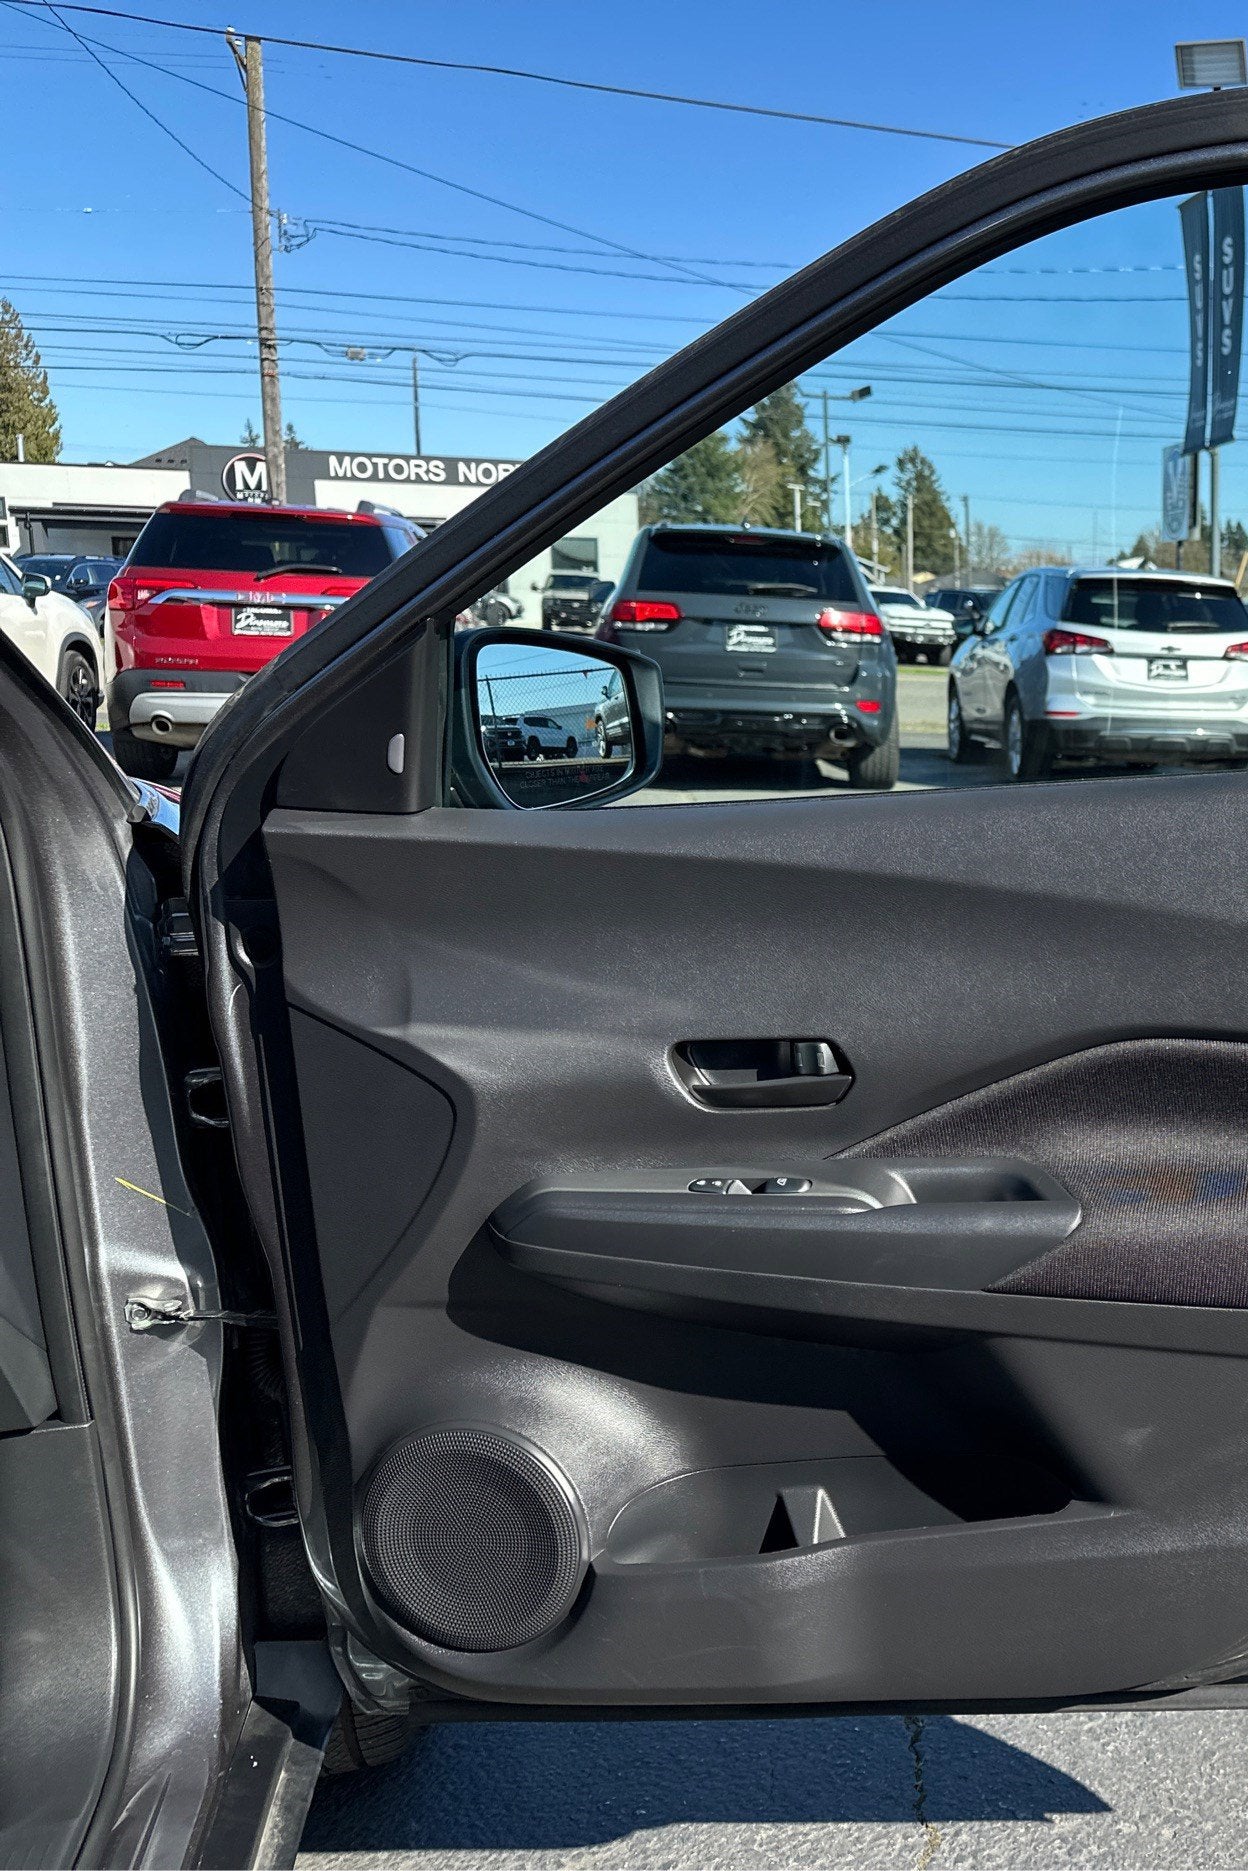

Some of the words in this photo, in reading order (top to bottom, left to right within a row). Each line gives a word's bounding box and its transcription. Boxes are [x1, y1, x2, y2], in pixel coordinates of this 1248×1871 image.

[1221, 235, 1235, 356] SUVS
[233, 460, 268, 492] M
[328, 455, 447, 482] MOTORS
[457, 461, 522, 485] NOR
